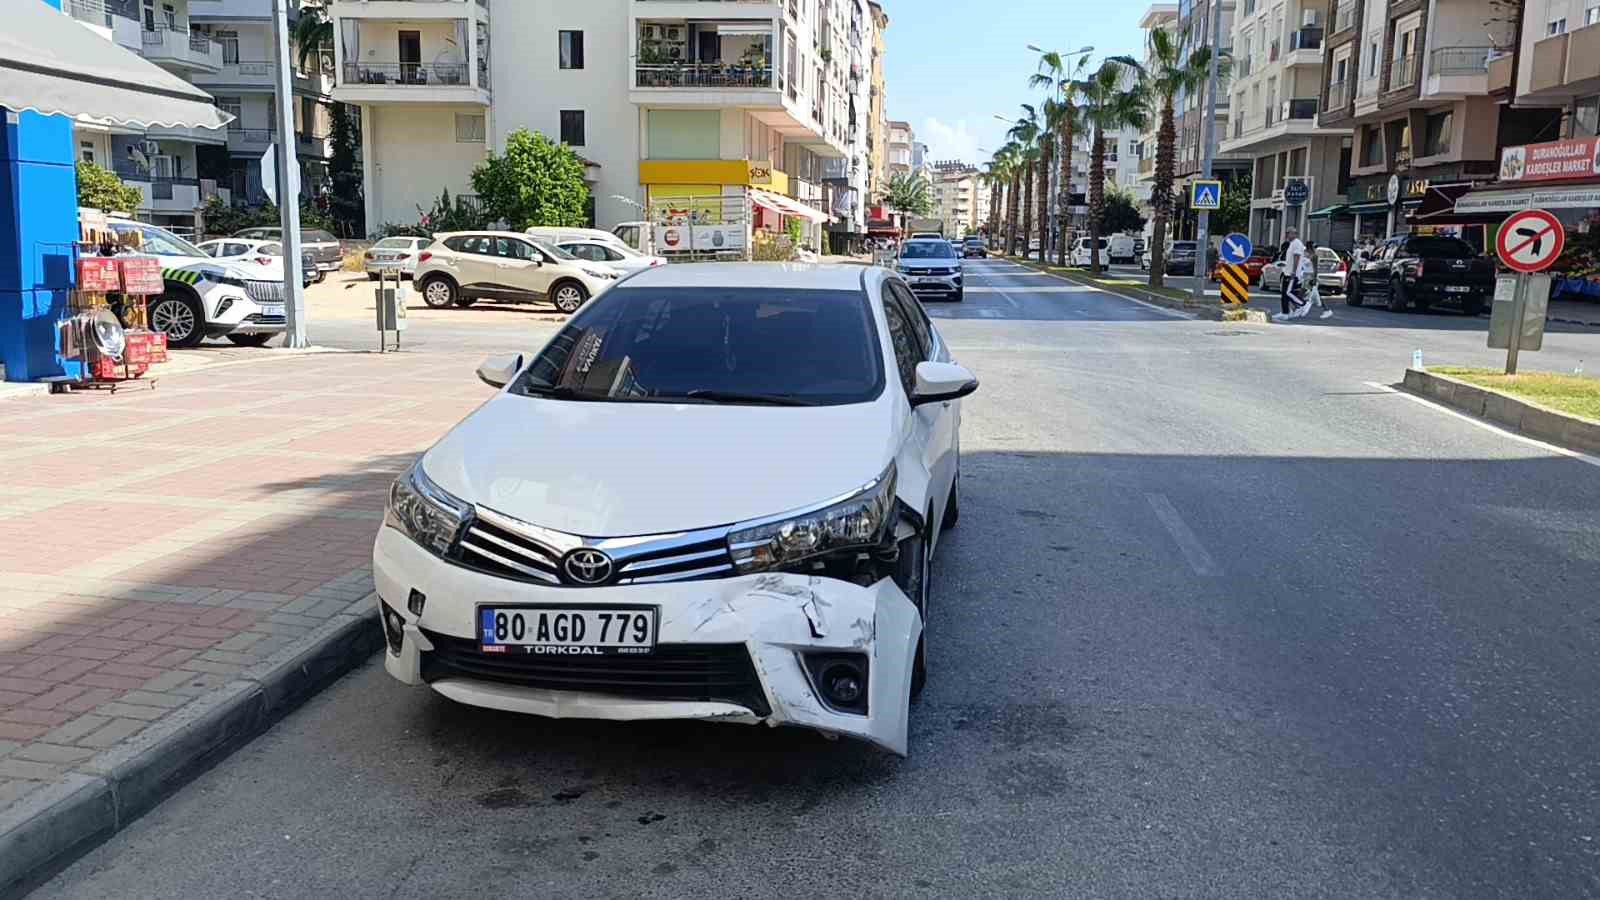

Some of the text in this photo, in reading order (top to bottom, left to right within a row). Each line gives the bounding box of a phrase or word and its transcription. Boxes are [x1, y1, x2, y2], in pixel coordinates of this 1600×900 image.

[495, 612, 648, 643] 80 AGD 779
